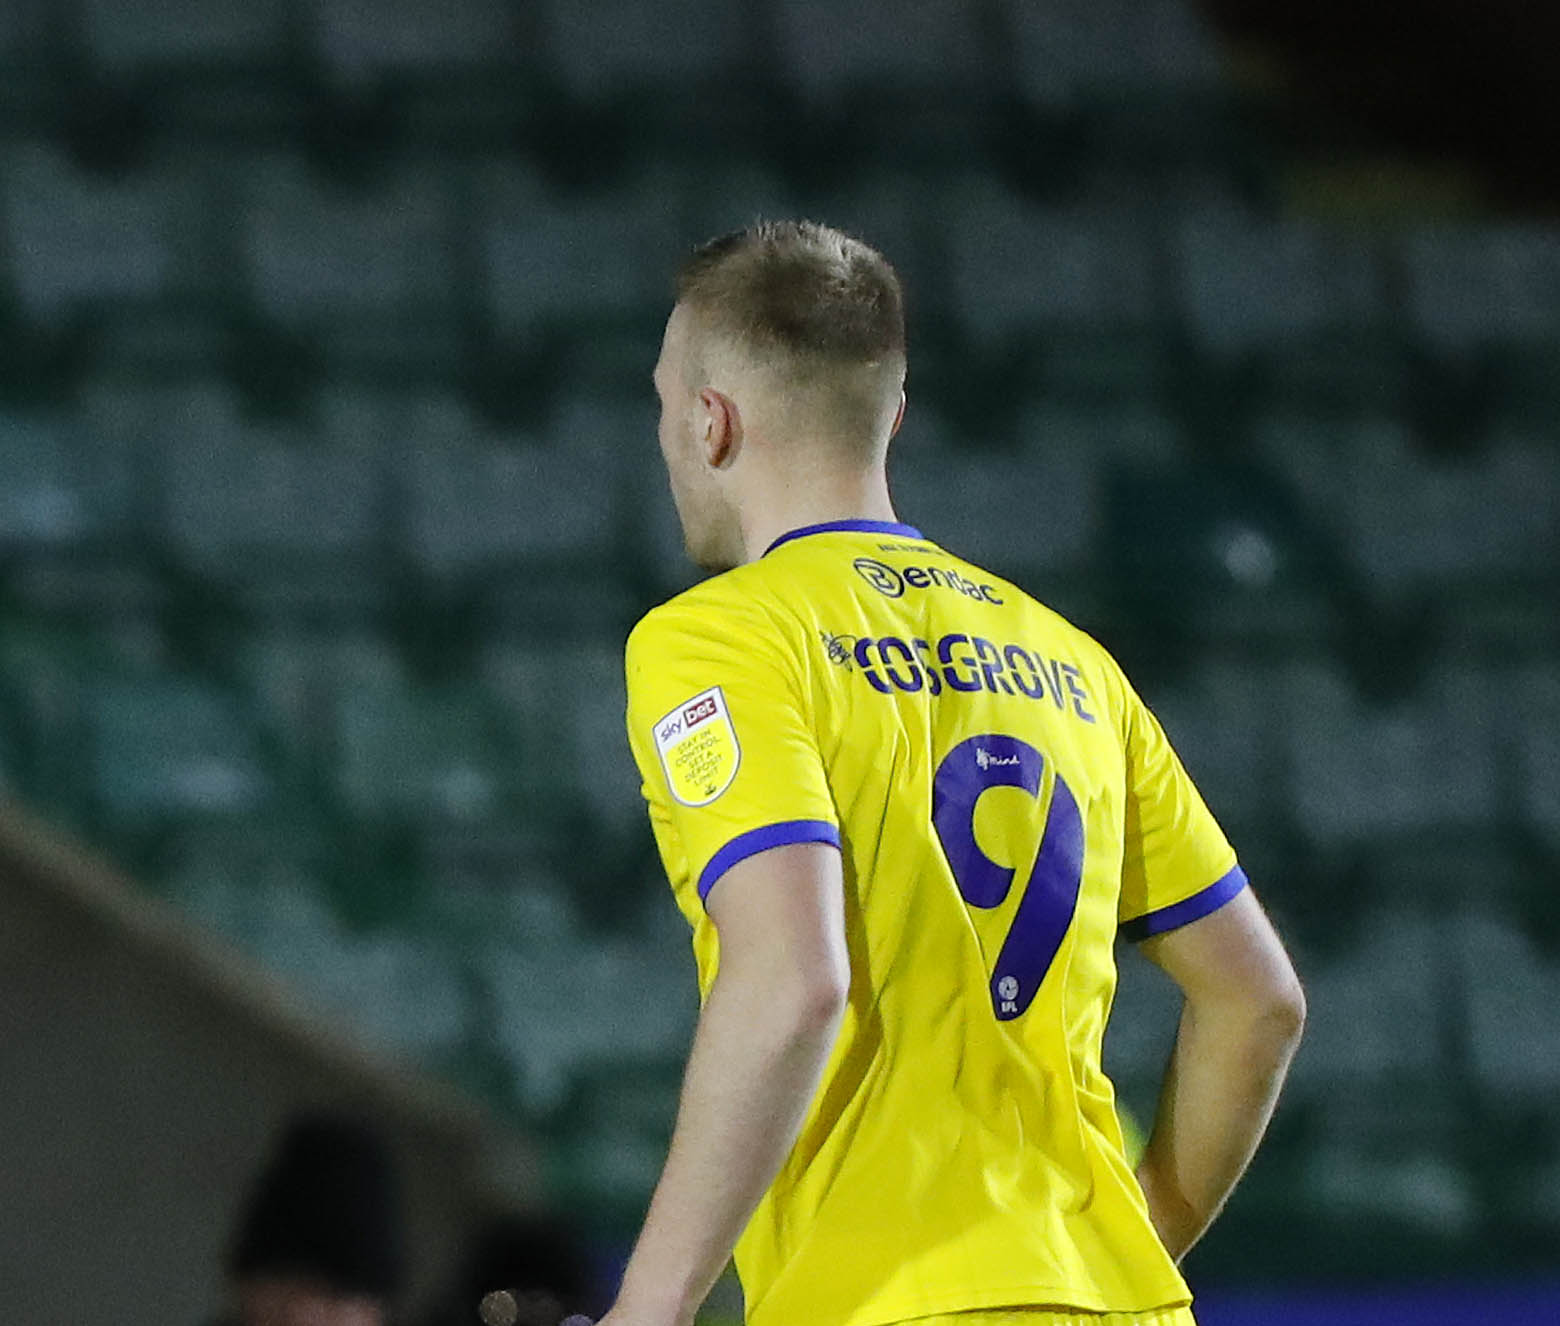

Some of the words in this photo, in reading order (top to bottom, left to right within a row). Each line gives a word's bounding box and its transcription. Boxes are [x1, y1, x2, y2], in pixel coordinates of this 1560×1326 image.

[661, 719, 682, 742] sky
[686, 699, 715, 725] bet
[854, 633, 1097, 724] COSGROVE
[932, 734, 1084, 1021] 9
